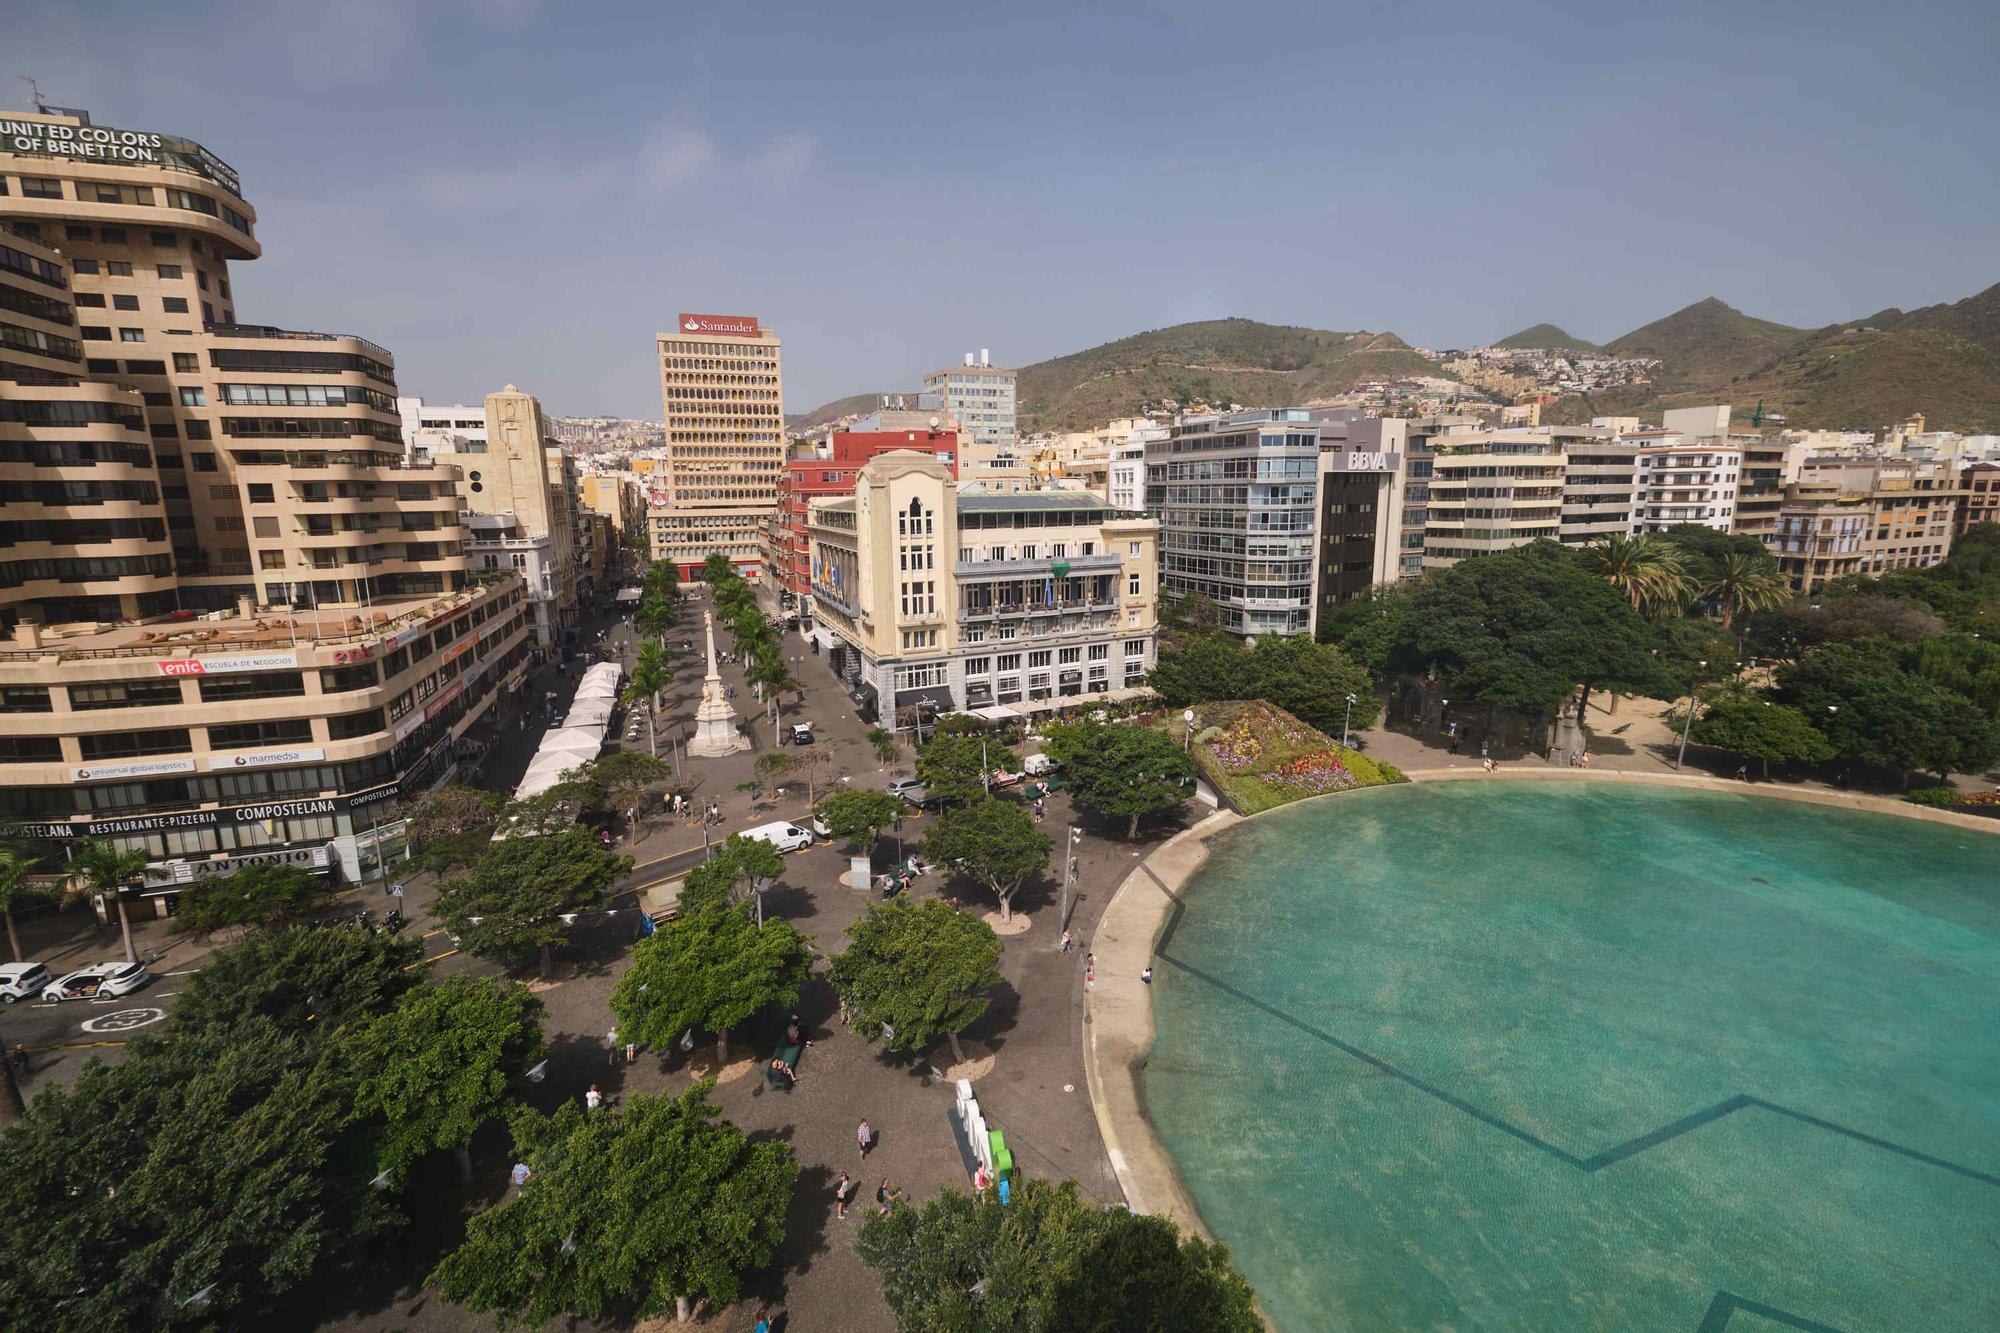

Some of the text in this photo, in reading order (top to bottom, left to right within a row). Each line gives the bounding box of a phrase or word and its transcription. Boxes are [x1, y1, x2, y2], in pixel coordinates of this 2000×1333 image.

[0, 121, 162, 148] UNITED COLORS
[15, 137, 159, 162] OF BENETTON.
[701, 320, 753, 333] Santander
[1348, 451, 1387, 471] BBVA
[165, 660, 200, 674] enic
[204, 661, 238, 669] ESCUELA
[253, 658, 292, 666] NEGOCIOS
[249, 752, 299, 763] marmedsa
[91, 760, 188, 777] universal global logistics
[350, 786, 399, 807] COMPOSTELANA
[236, 800, 336, 821] COMPOSTELANA
[89, 812, 217, 834] RESTAURANTE-PIZZERIA
[197, 850, 309, 874] ANTONIO
